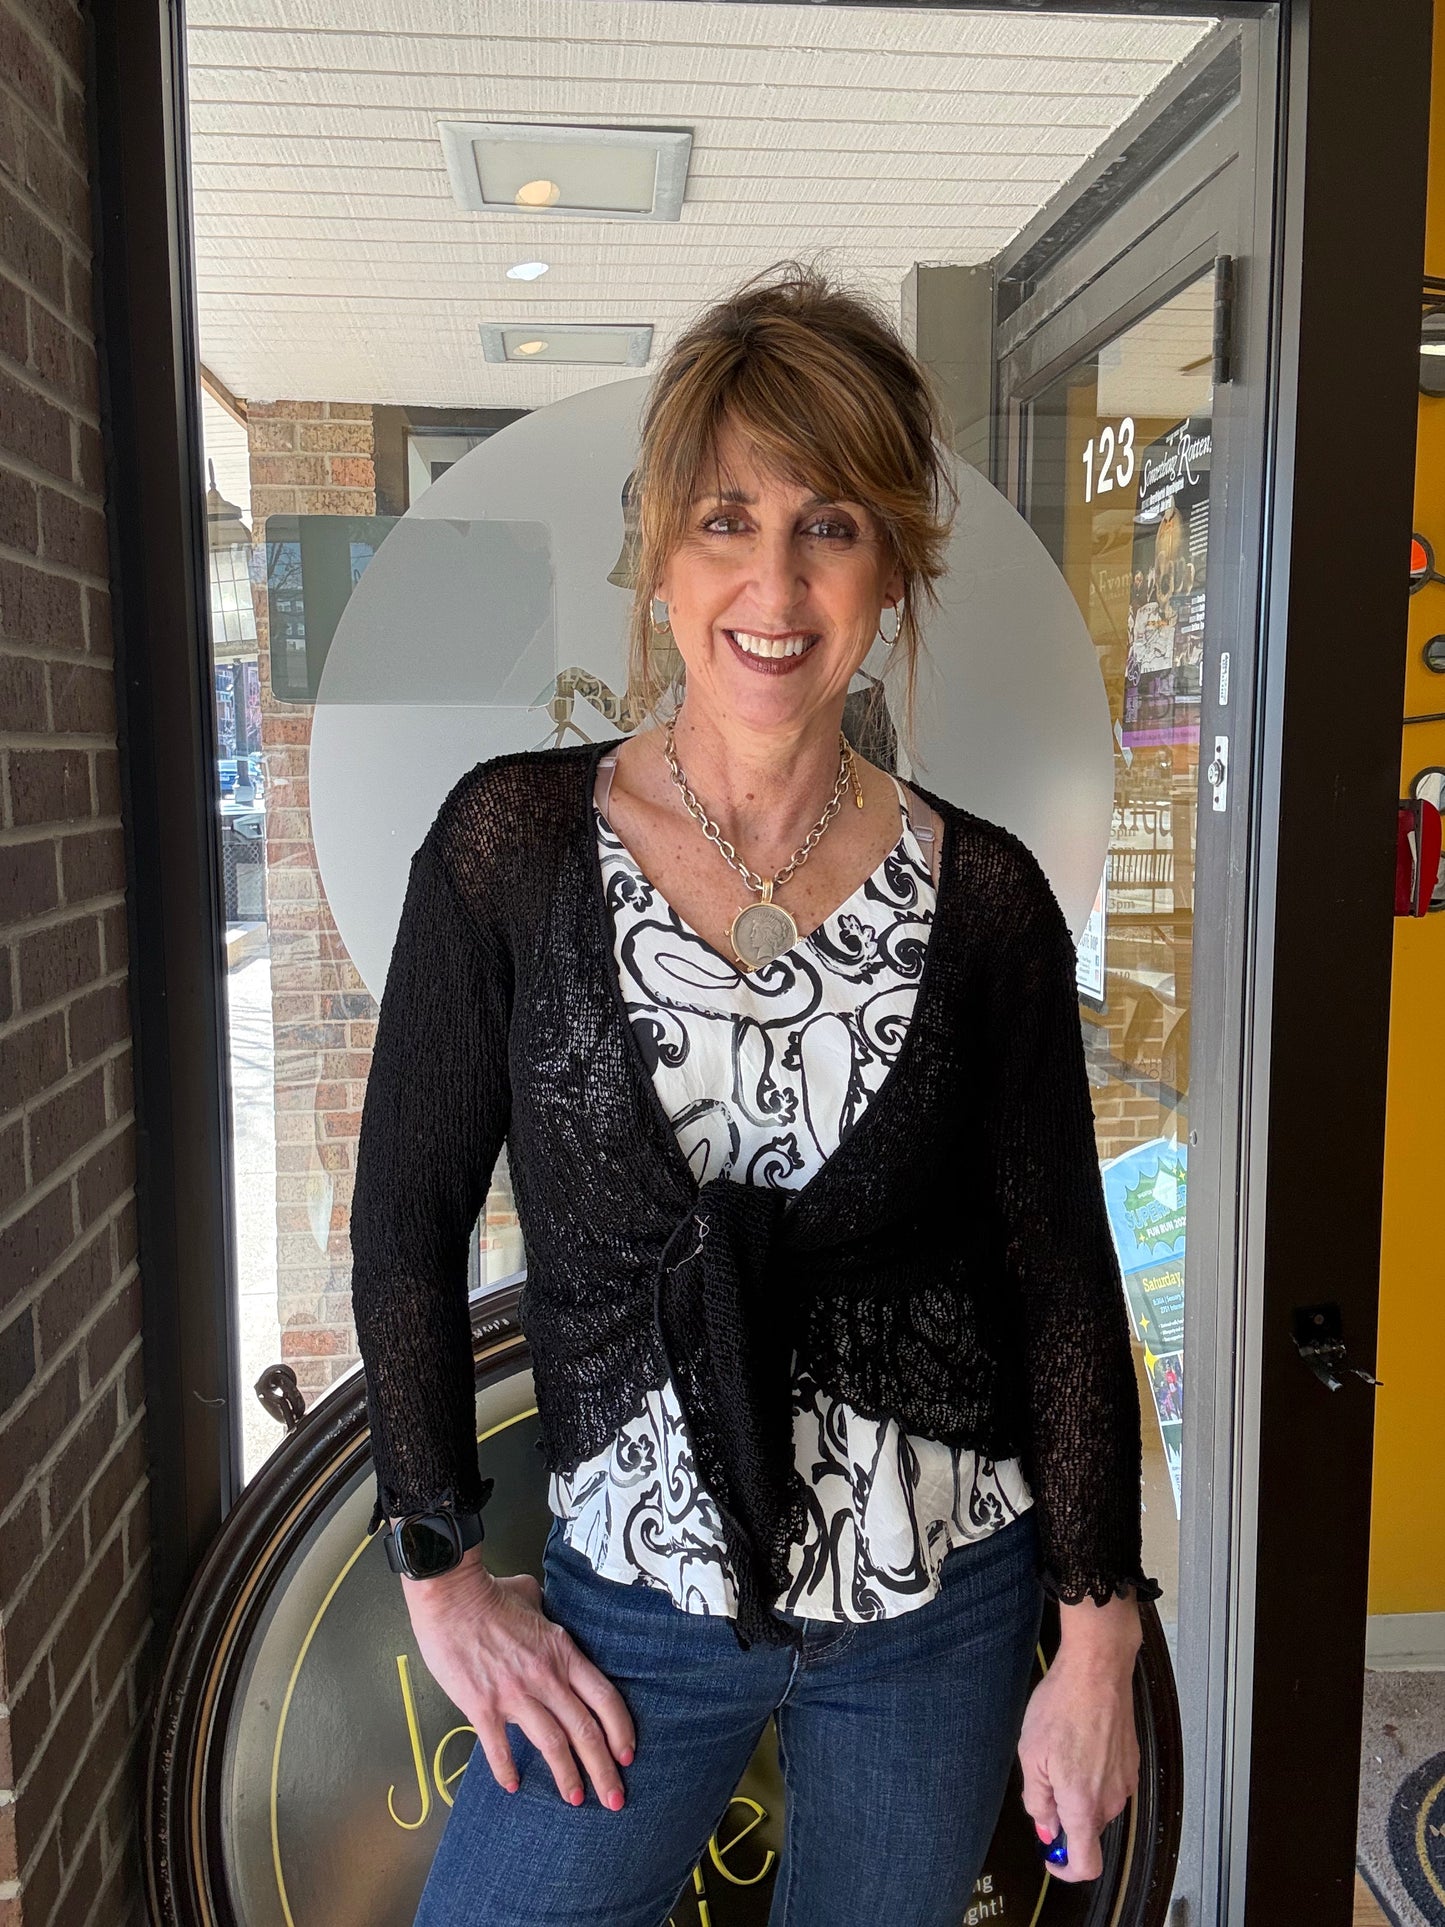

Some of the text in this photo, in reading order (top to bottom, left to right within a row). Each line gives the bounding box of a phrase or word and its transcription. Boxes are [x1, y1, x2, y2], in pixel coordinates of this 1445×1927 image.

[1082, 417, 1135, 503] 123
[1146, 1224, 1161, 1239] FUN
[1160, 1220, 1175, 1234] RUN
